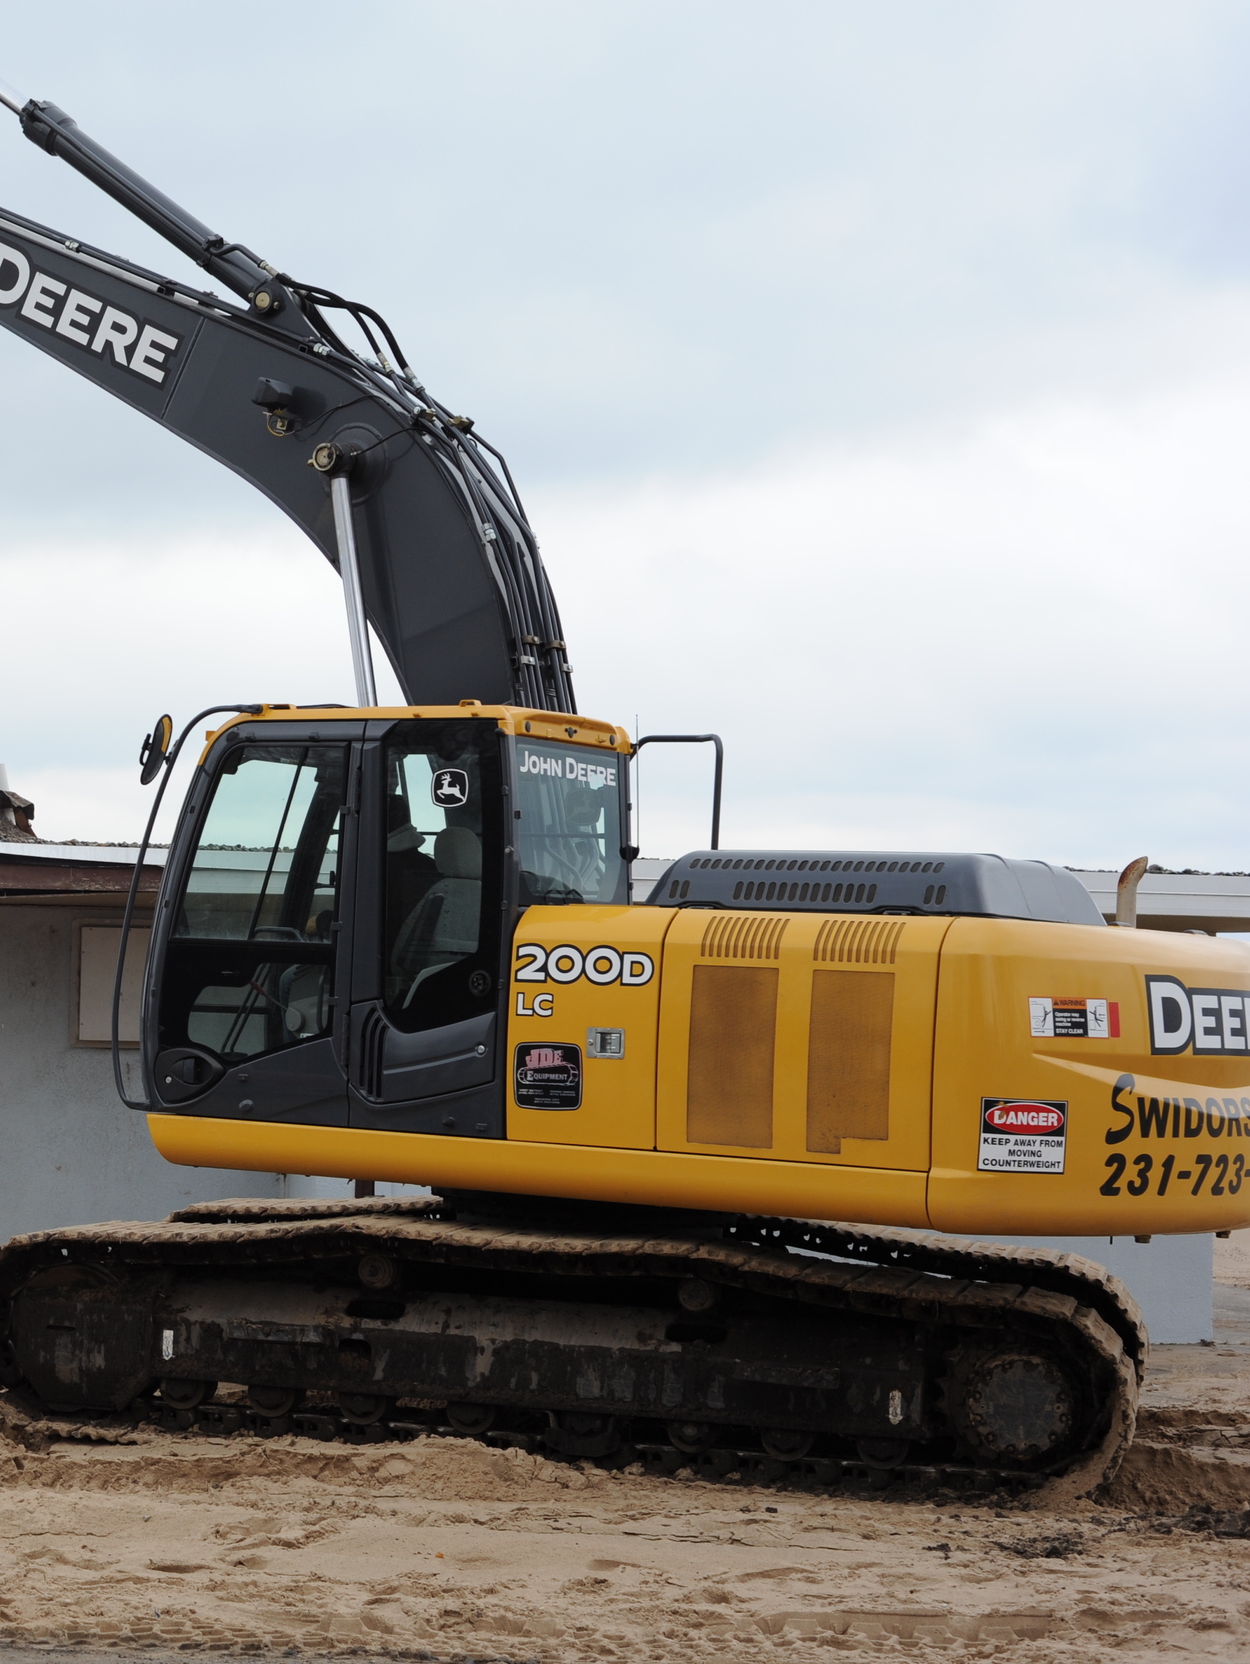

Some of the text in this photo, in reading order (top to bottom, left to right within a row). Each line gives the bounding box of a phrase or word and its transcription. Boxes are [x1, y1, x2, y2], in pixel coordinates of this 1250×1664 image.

[519, 750, 616, 787] JOHN DEERE
[515, 944, 654, 985] 200D
[516, 992, 554, 1017] LC
[1148, 980, 1250, 1051] DEE
[526, 1070, 568, 1081] EQUIPMENT
[993, 1110, 1058, 1126] DANGER
[983, 1137, 1063, 1148] KEEP AWAY FROM
[1008, 1149, 1042, 1158] MOVING
[982, 1158, 1061, 1169] COUNTERWEIGHT
